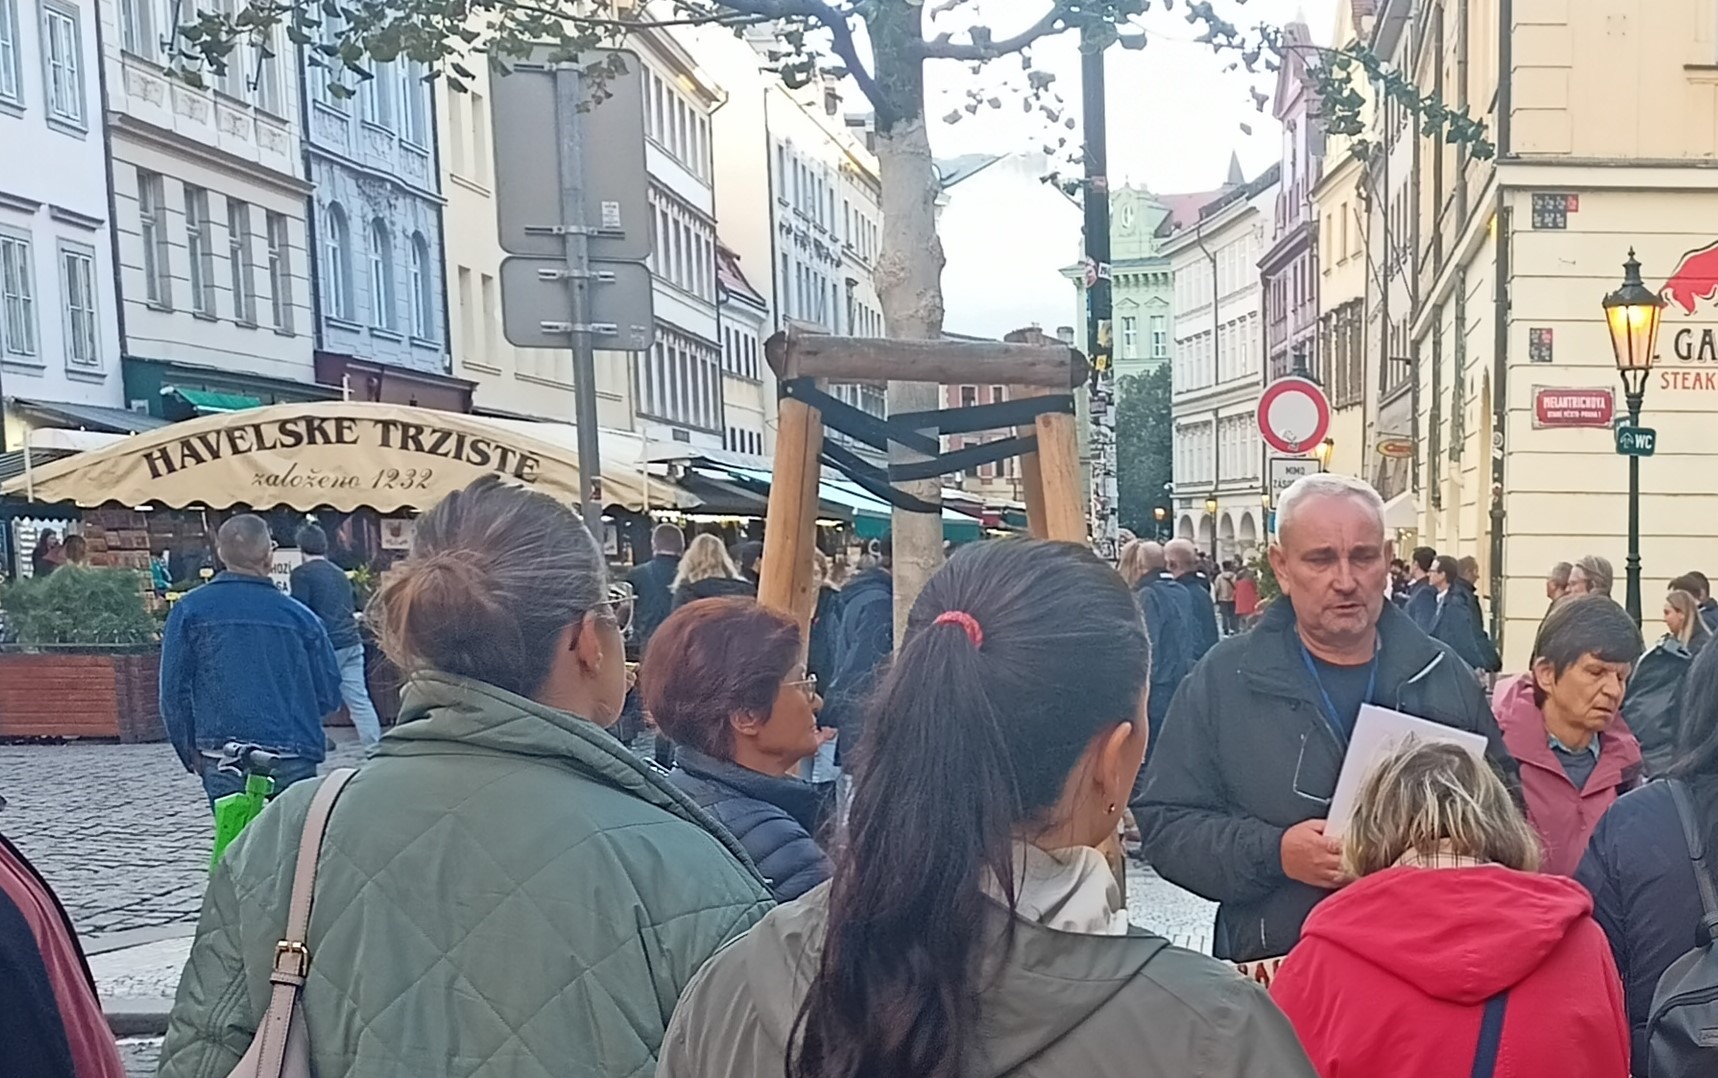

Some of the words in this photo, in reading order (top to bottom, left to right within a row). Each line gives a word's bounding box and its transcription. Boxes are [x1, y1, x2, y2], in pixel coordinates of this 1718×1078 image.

[1634, 434, 1653, 449] WC
[251, 461, 361, 489] založeno
[371, 468, 433, 489] 1232
